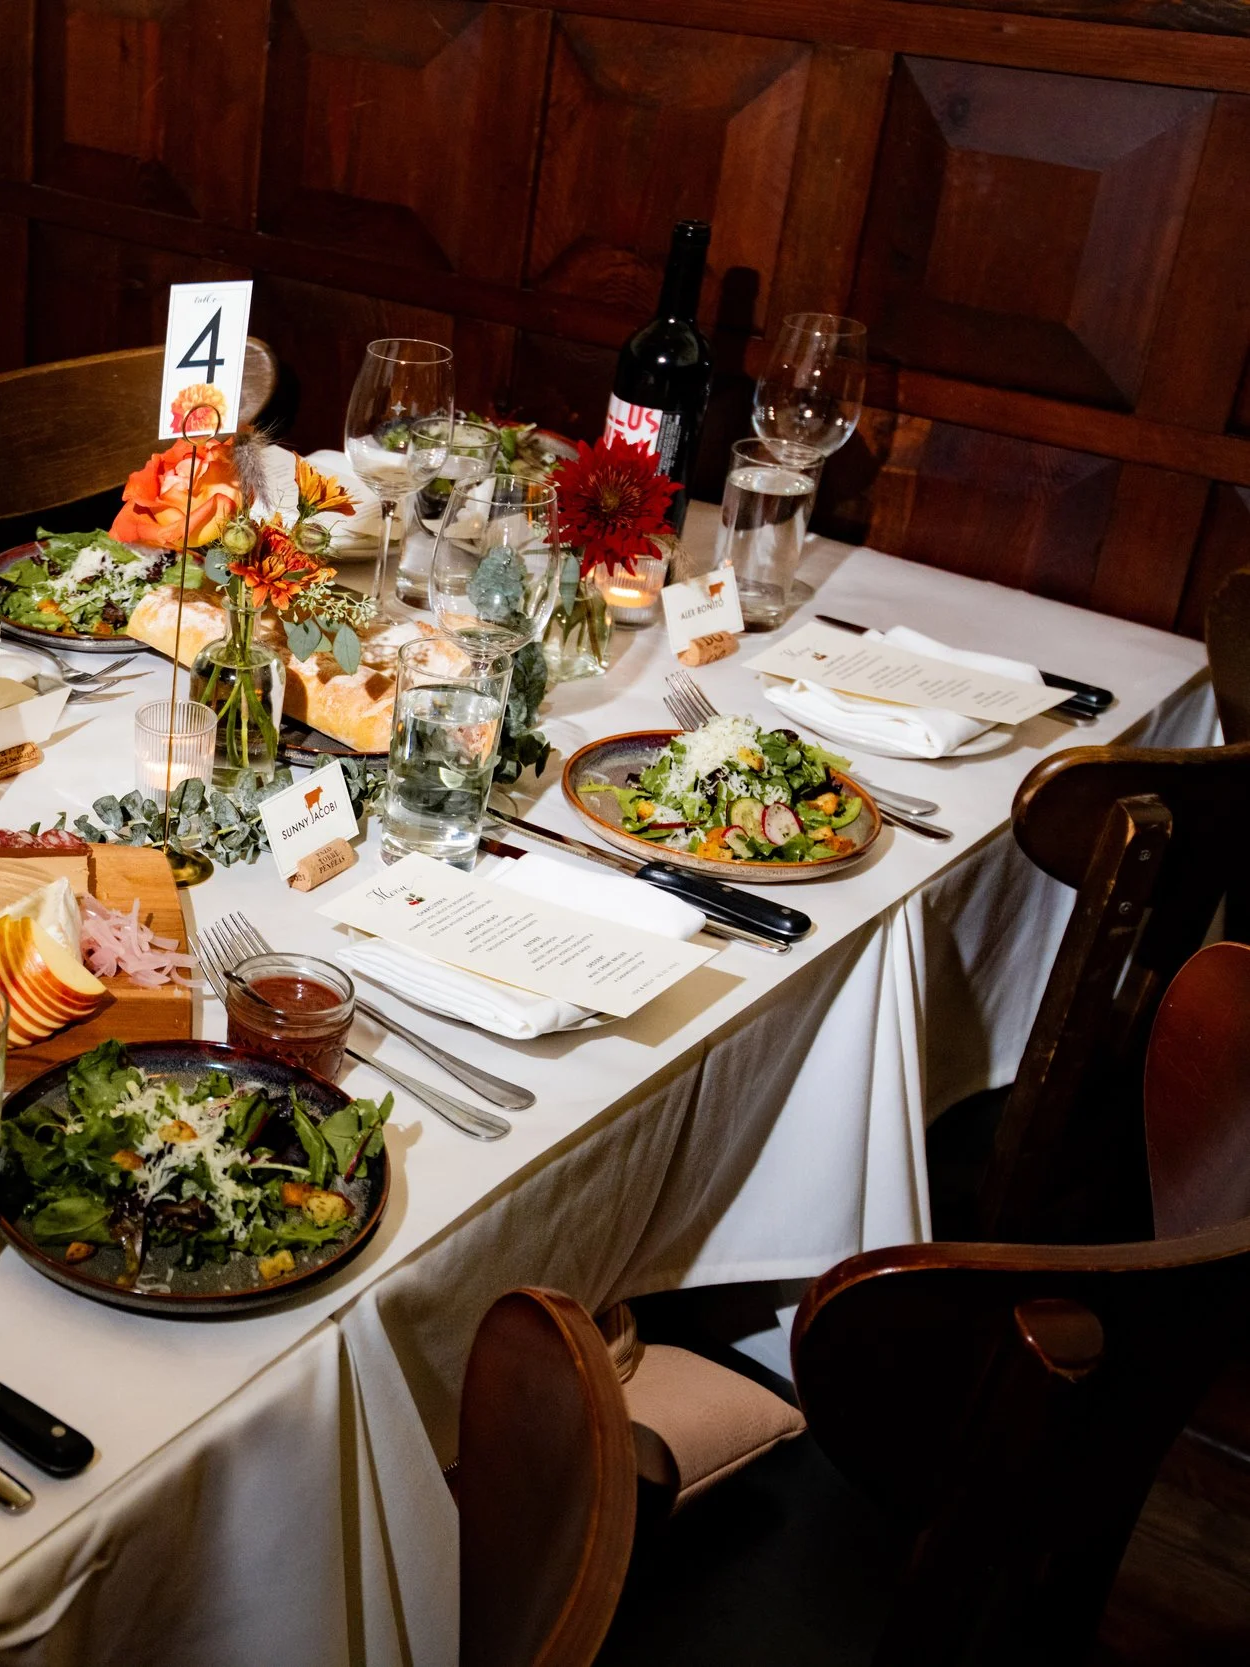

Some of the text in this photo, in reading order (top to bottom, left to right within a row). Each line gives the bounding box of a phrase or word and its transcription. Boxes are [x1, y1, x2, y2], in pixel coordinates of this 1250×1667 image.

[176, 305, 225, 384] 4
[680, 599, 725, 620] ALEX BONITO
[281, 801, 338, 841] SUNNY JACOBI
[366, 878, 418, 905] Menu
